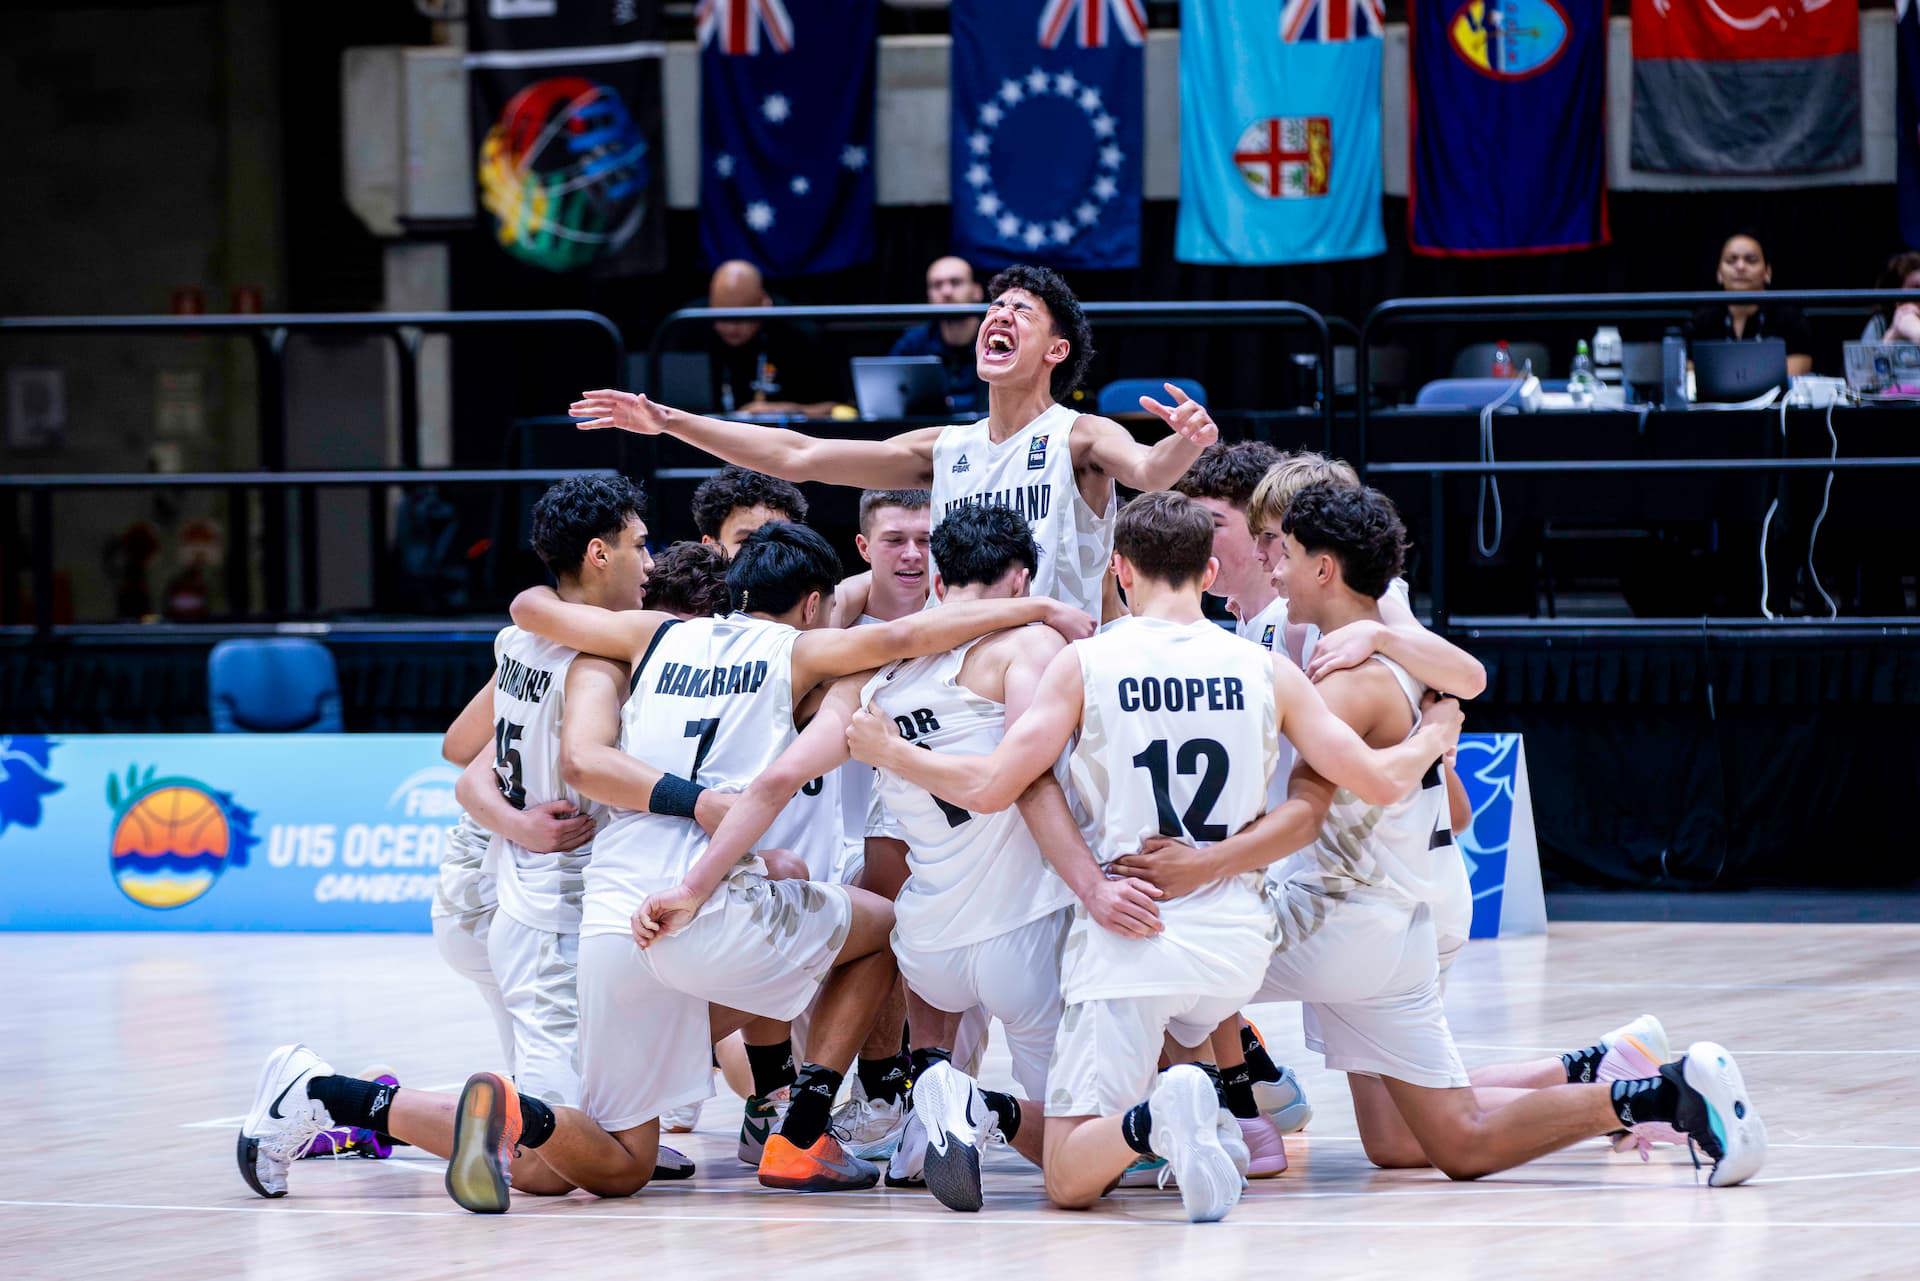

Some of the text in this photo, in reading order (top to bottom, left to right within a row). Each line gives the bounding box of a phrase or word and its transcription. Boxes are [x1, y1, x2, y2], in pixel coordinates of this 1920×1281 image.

[1118, 676, 1245, 712] COOPER
[684, 718, 720, 783] 7
[1132, 738, 1230, 842] 12
[268, 824, 337, 867] U15
